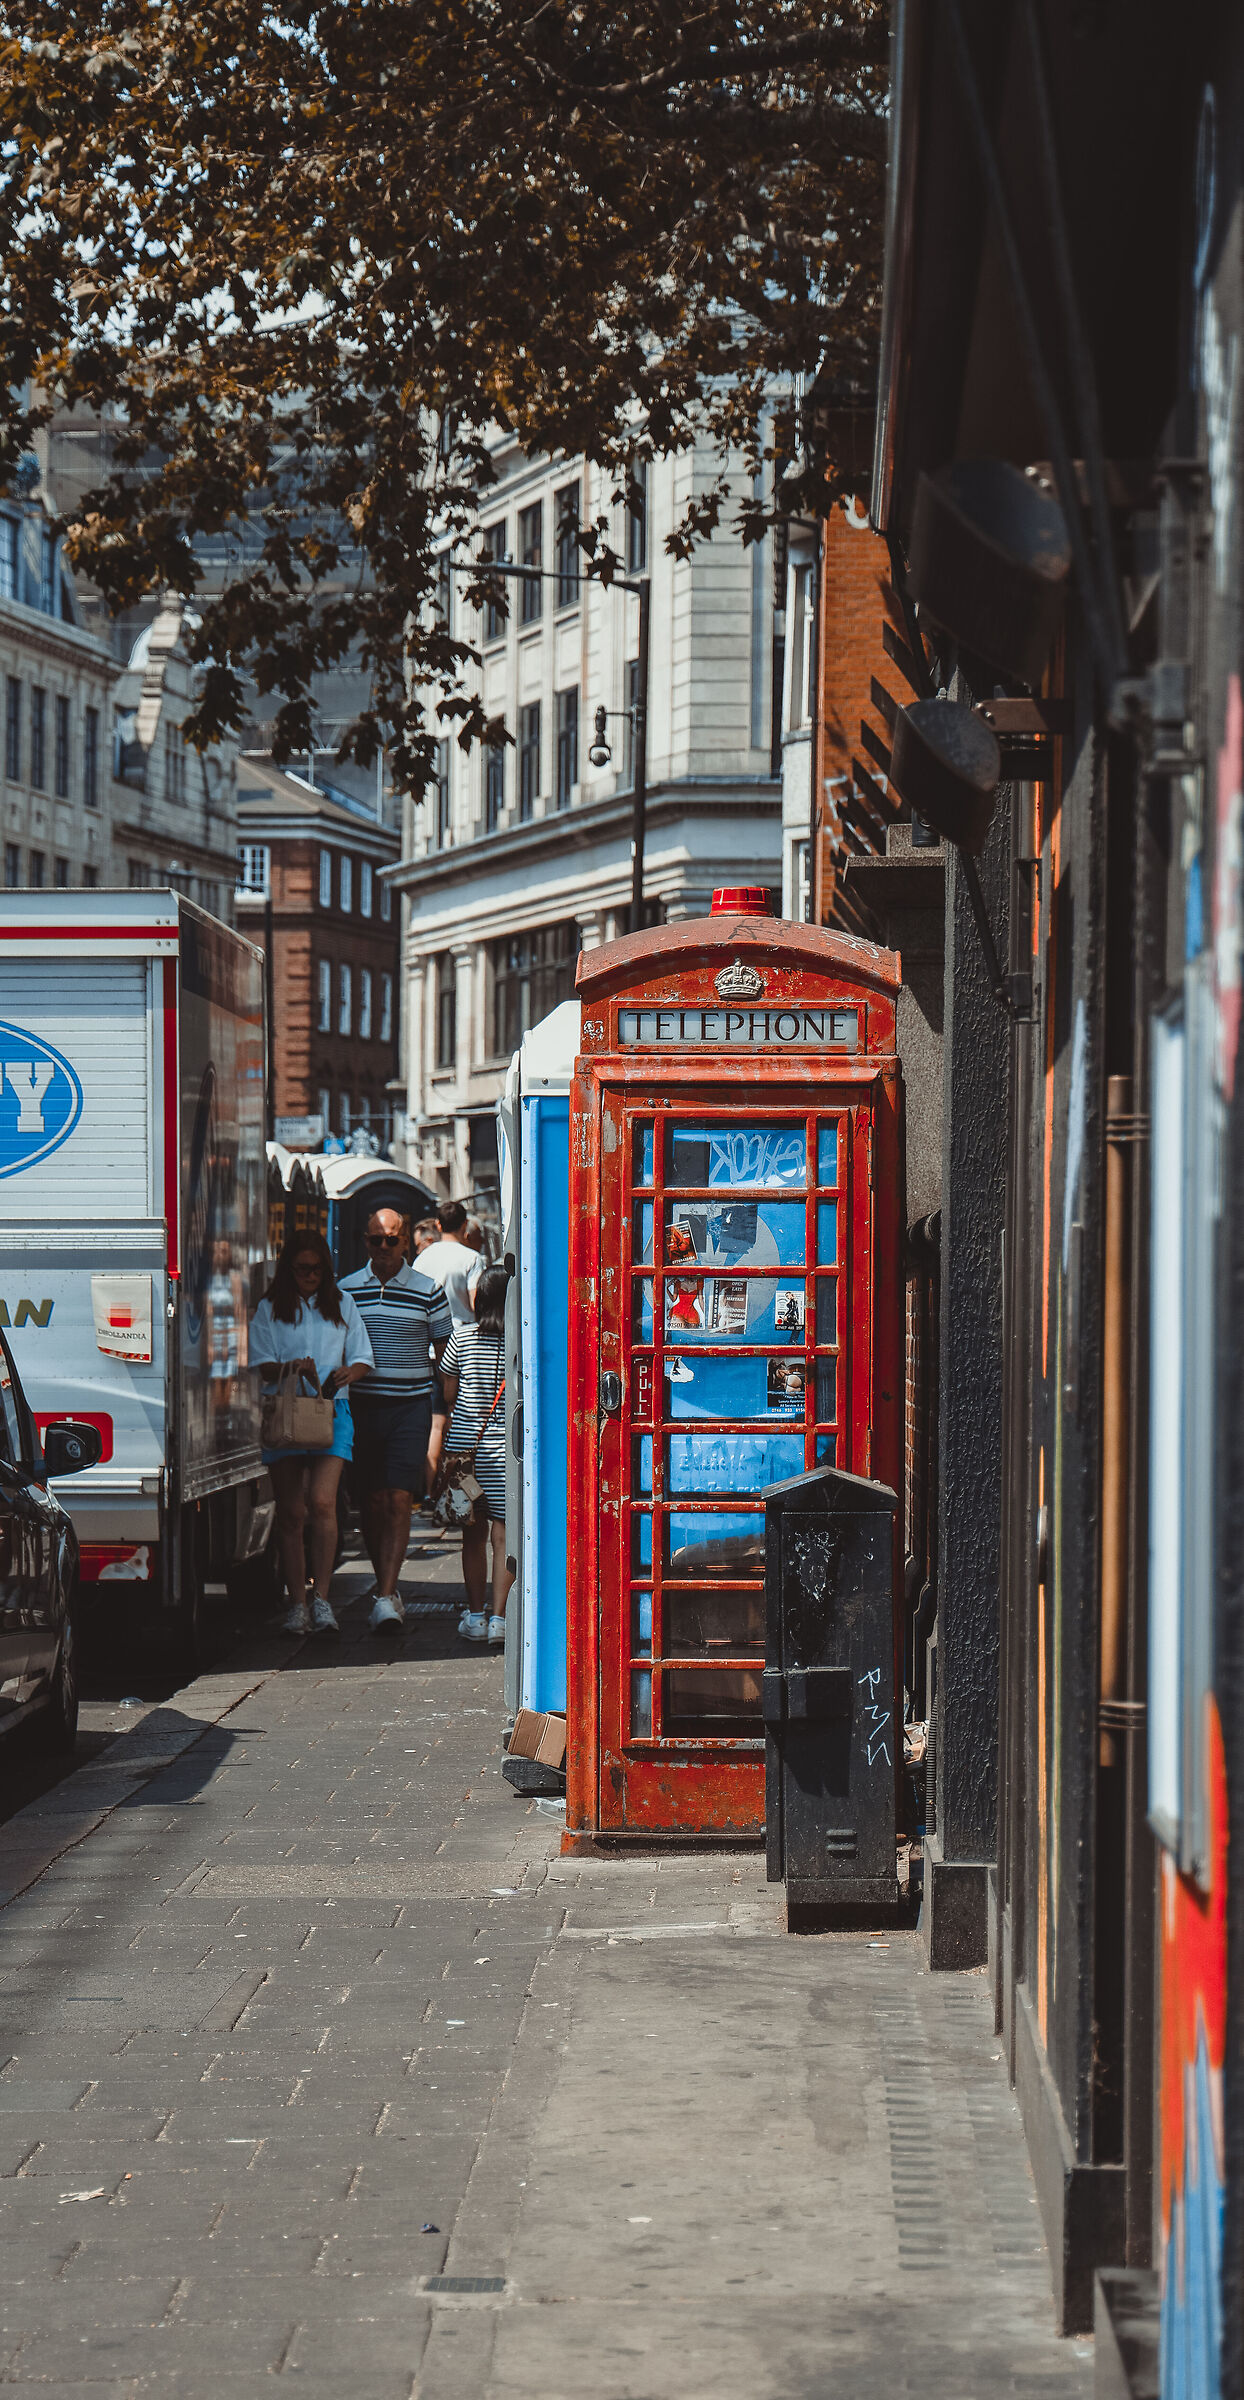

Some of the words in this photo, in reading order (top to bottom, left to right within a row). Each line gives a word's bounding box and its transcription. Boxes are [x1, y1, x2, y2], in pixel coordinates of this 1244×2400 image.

[625, 1012, 848, 1041] TELEPHONE
[0, 1062, 55, 1133] Y
[97, 1328, 147, 1340] DHOLLANDIA
[639, 1365, 648, 1415] PULL
